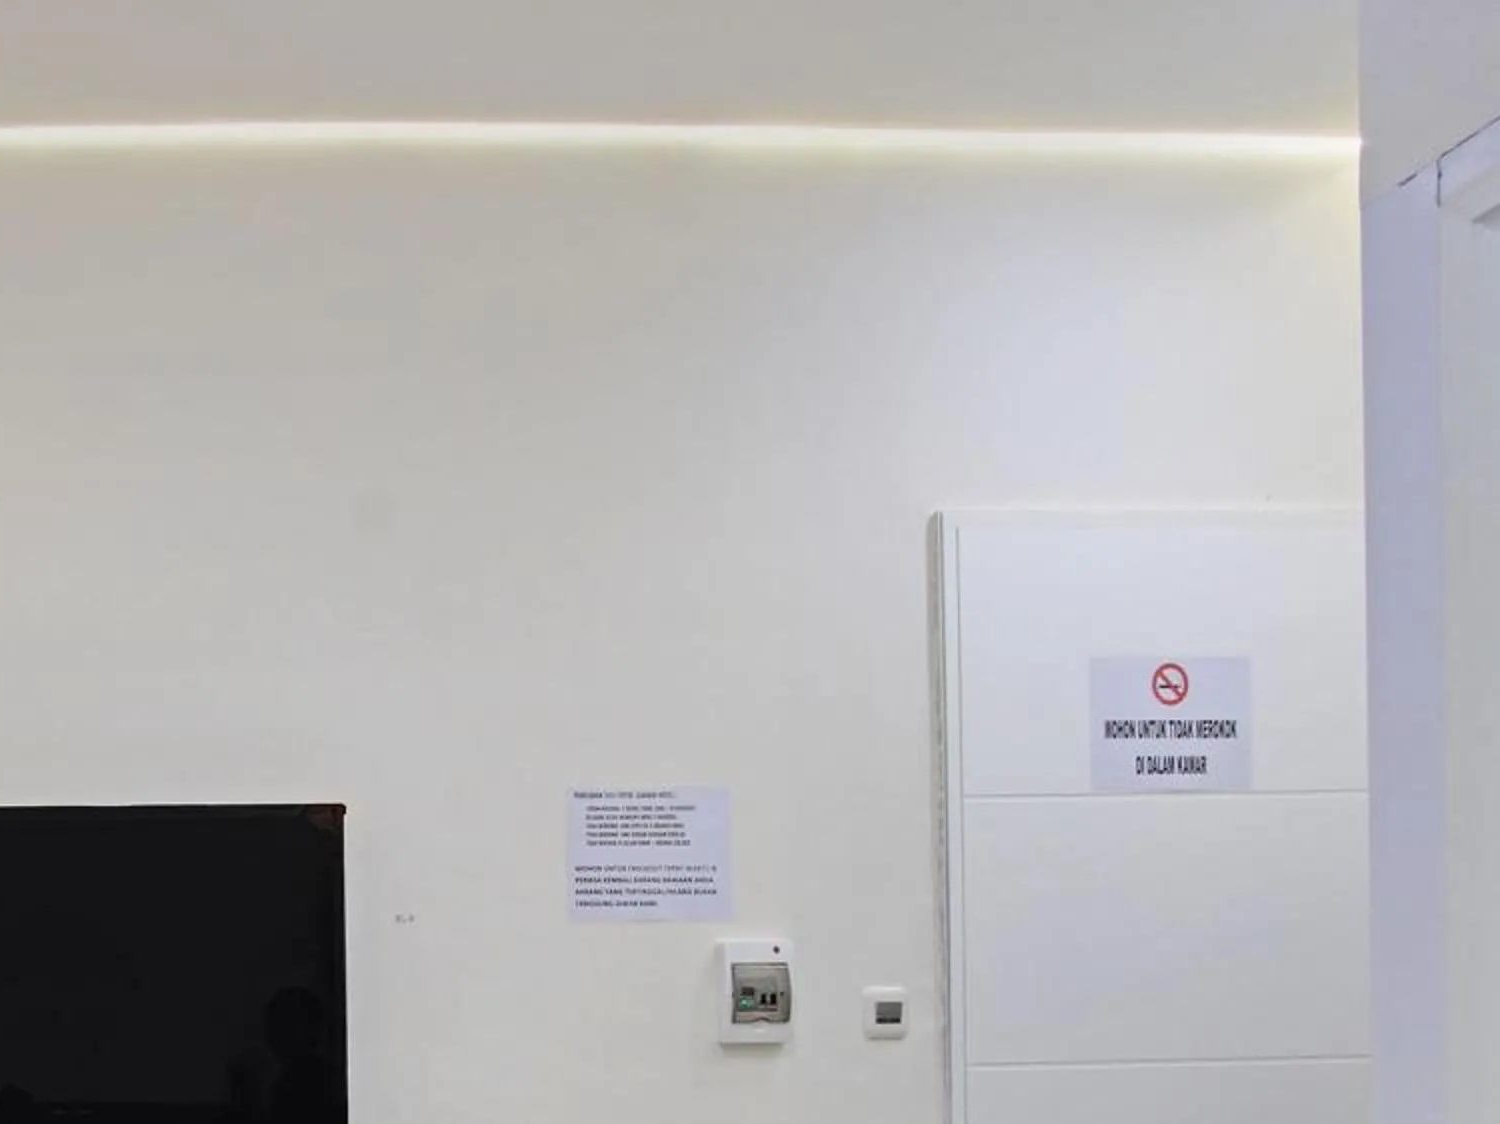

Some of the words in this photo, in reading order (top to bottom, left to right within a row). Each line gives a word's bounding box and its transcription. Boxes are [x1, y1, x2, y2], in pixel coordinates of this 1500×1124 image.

[1104, 719, 1136, 739] MOHON
[1137, 719, 1167, 739] UNTUK
[1168, 719, 1194, 739] TIDAK
[1195, 719, 1237, 739] MEROKOK
[1135, 755, 1145, 775] DI
[1146, 755, 1175, 775] DALAM
[1177, 755, 1207, 775] KAMAR
